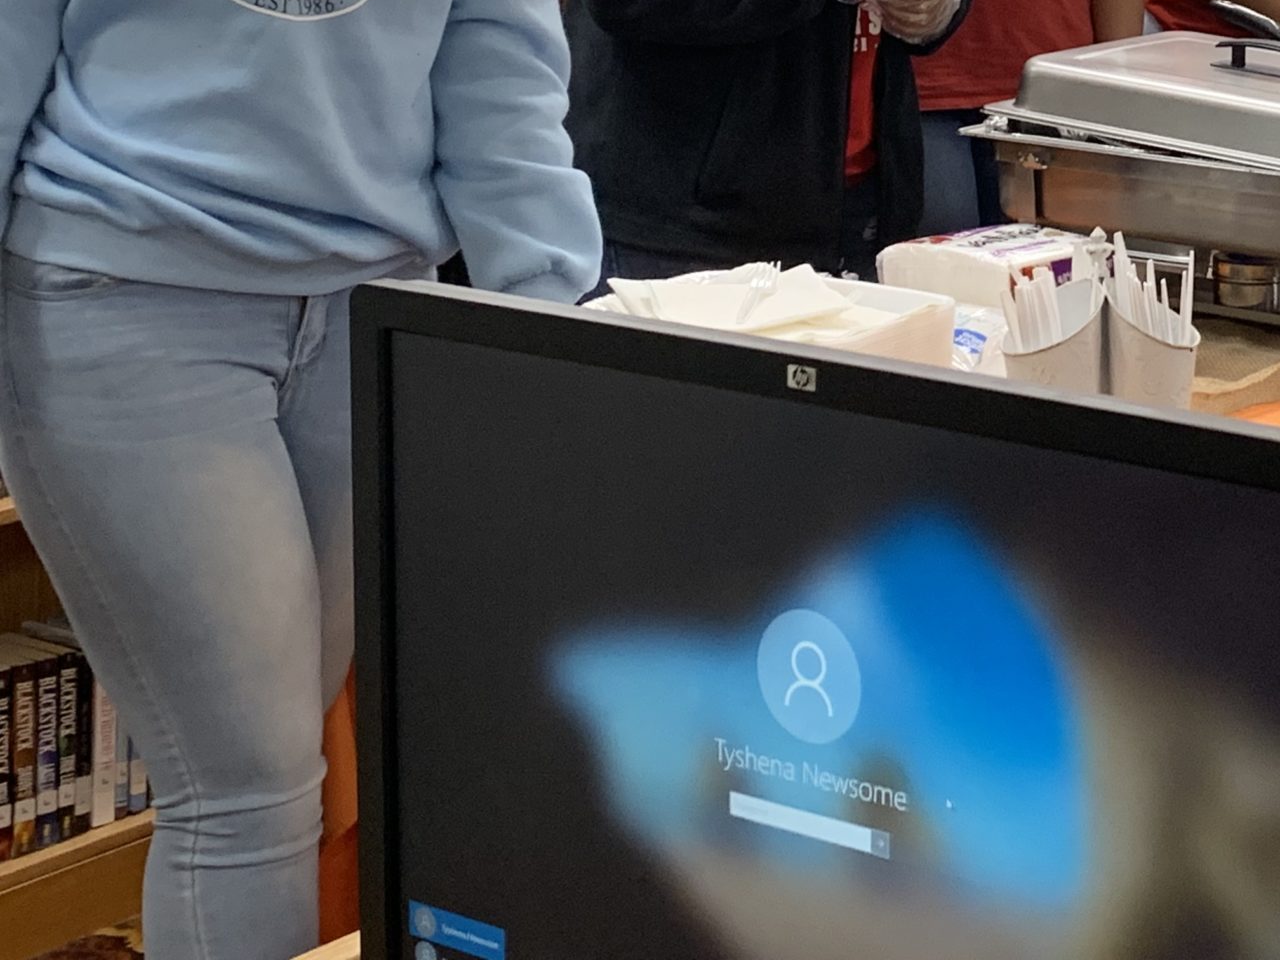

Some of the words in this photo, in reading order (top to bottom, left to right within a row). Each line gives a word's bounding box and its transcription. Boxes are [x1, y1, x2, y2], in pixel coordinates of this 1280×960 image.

[16, 680, 34, 751] BLACKSTOCK
[38, 675, 57, 754] BLACKSTOCK
[60, 667, 77, 736] BLACKSTOCK
[714, 738, 795, 781] Tyshena
[803, 760, 907, 811] Newsome
